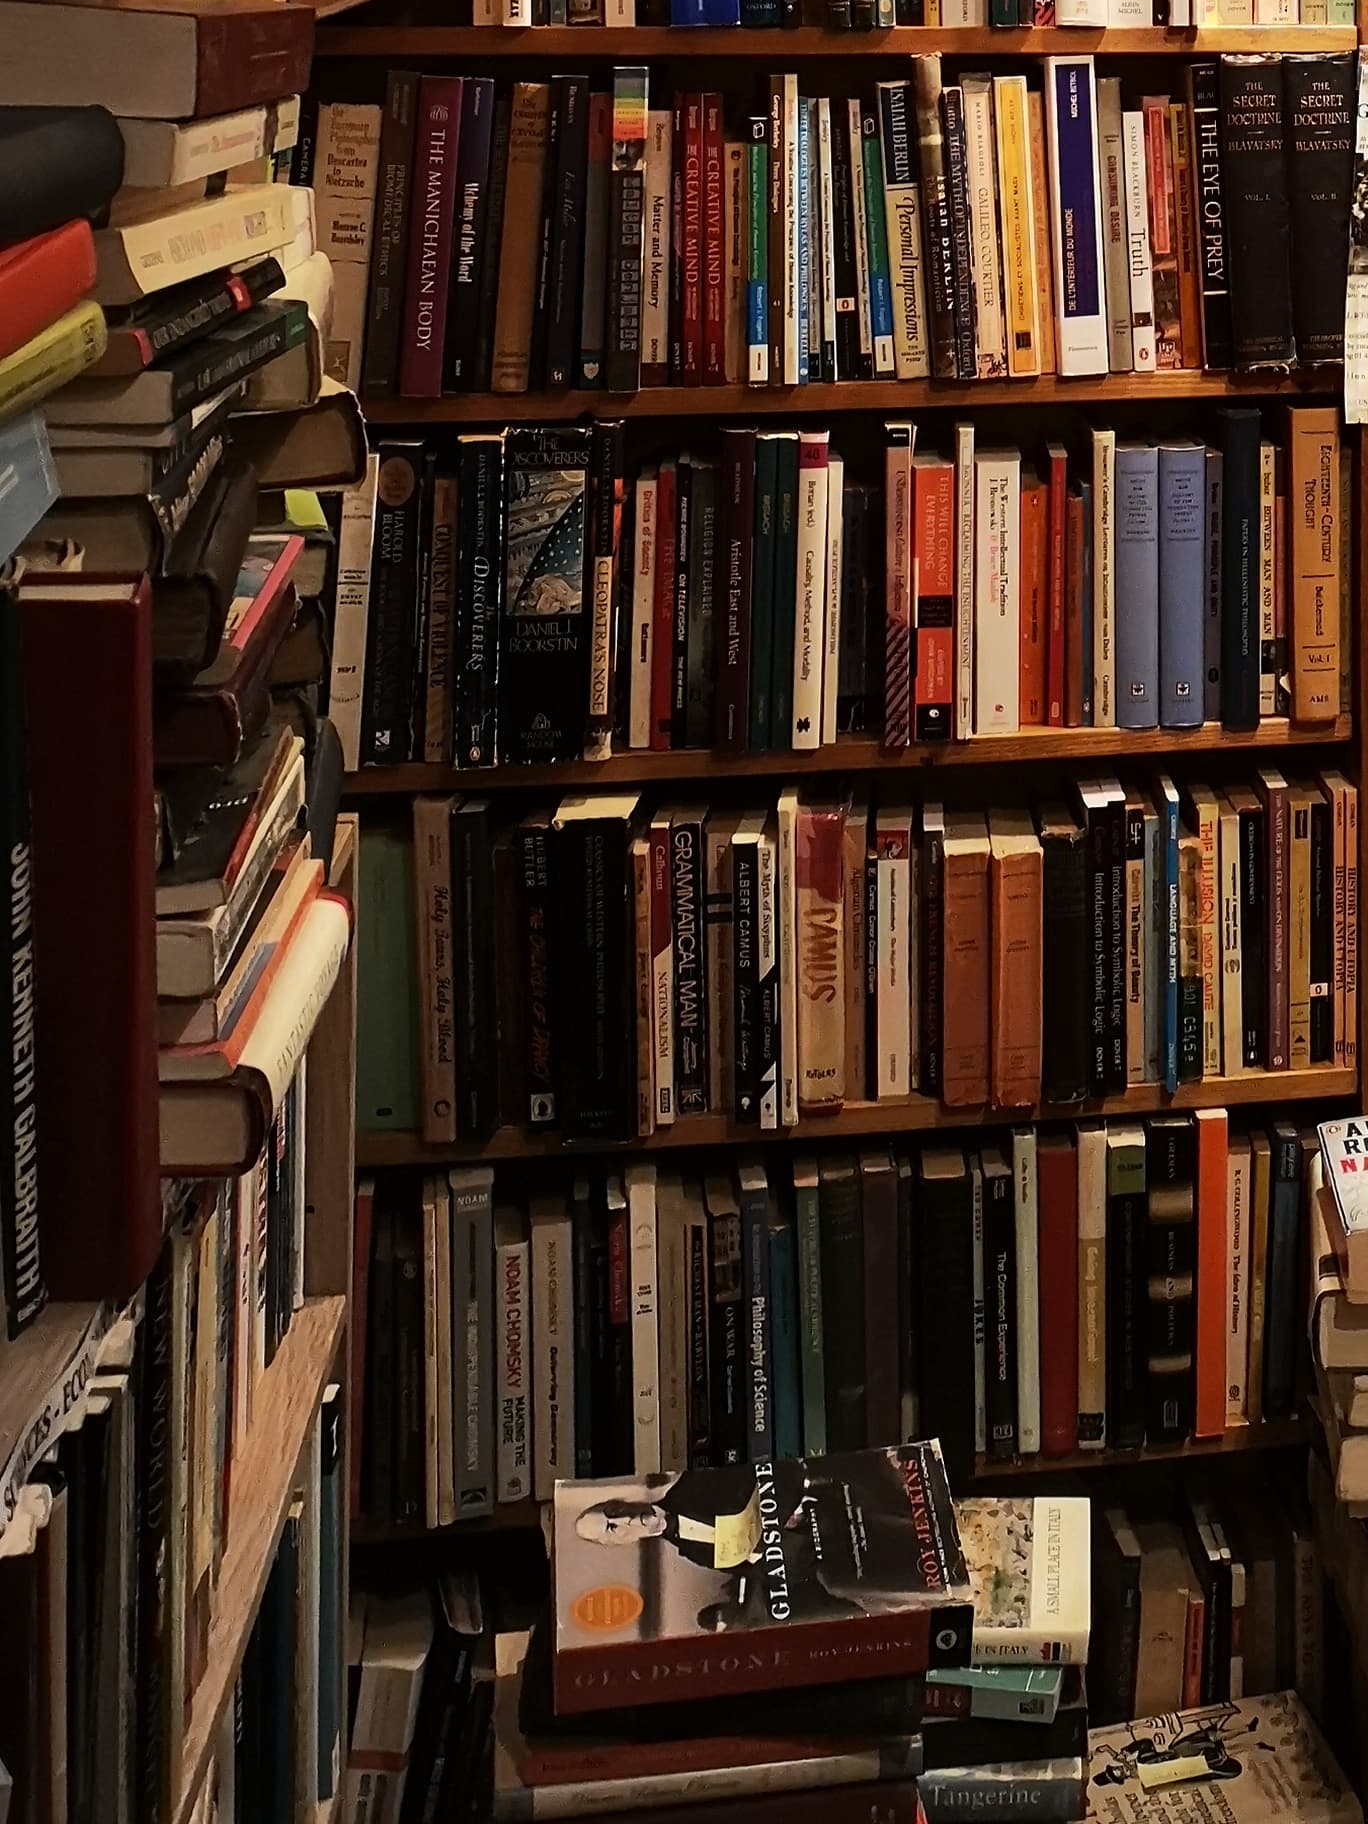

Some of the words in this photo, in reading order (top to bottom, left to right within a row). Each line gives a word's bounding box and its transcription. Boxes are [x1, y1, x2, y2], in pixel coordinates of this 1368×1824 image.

[889, 87, 908, 133] ISAIAH
[1300, 94, 1344, 108] SECRET
[1312, 81, 1331, 91] THE
[1200, 121, 1218, 159] THE
[1294, 111, 1350, 125] DOCTRINE
[429, 130, 446, 165] THE
[893, 134, 910, 182] BERLIN
[1295, 138, 1351, 151] BLAVATSKY
[707, 159, 720, 234] CREATIVE
[1203, 163, 1220, 198] EYE
[420, 171, 442, 293] MANICHAEAN
[894, 197, 919, 261] Personal
[1205, 201, 1221, 229] OF
[708, 240, 720, 285] MIND
[1129, 228, 1149, 278] Truth
[1207, 234, 1224, 280] PREY
[416, 301, 433, 351] BODY
[899, 265, 921, 341] Impressions
[1304, 479, 1317, 530] THOUGHT
[728, 539, 742, 587] Aristotle
[594, 560, 608, 662] CLEOPATRA'S
[729, 589, 740, 613] East
[728, 615, 740, 636] and
[727, 638, 739, 666] West
[592, 668, 605, 712] NOSE
[674, 831, 696, 975] GRAMMATICAL
[739, 862, 751, 915] ALBERT
[739, 919, 751, 968] CAMUS
[11, 939, 35, 1103] KENNETH
[679, 980, 697, 1028] MAN
[505, 1255, 522, 1305] NOAM
[505, 1309, 522, 1388] CHOMSKY
[750, 1296, 766, 1366] Philosophy
[753, 1369, 767, 1383] of
[753, 1385, 767, 1432] Science
[755, 1462, 791, 1622] GLADSTONE
[929, 1785, 1041, 1807] Tangerine
